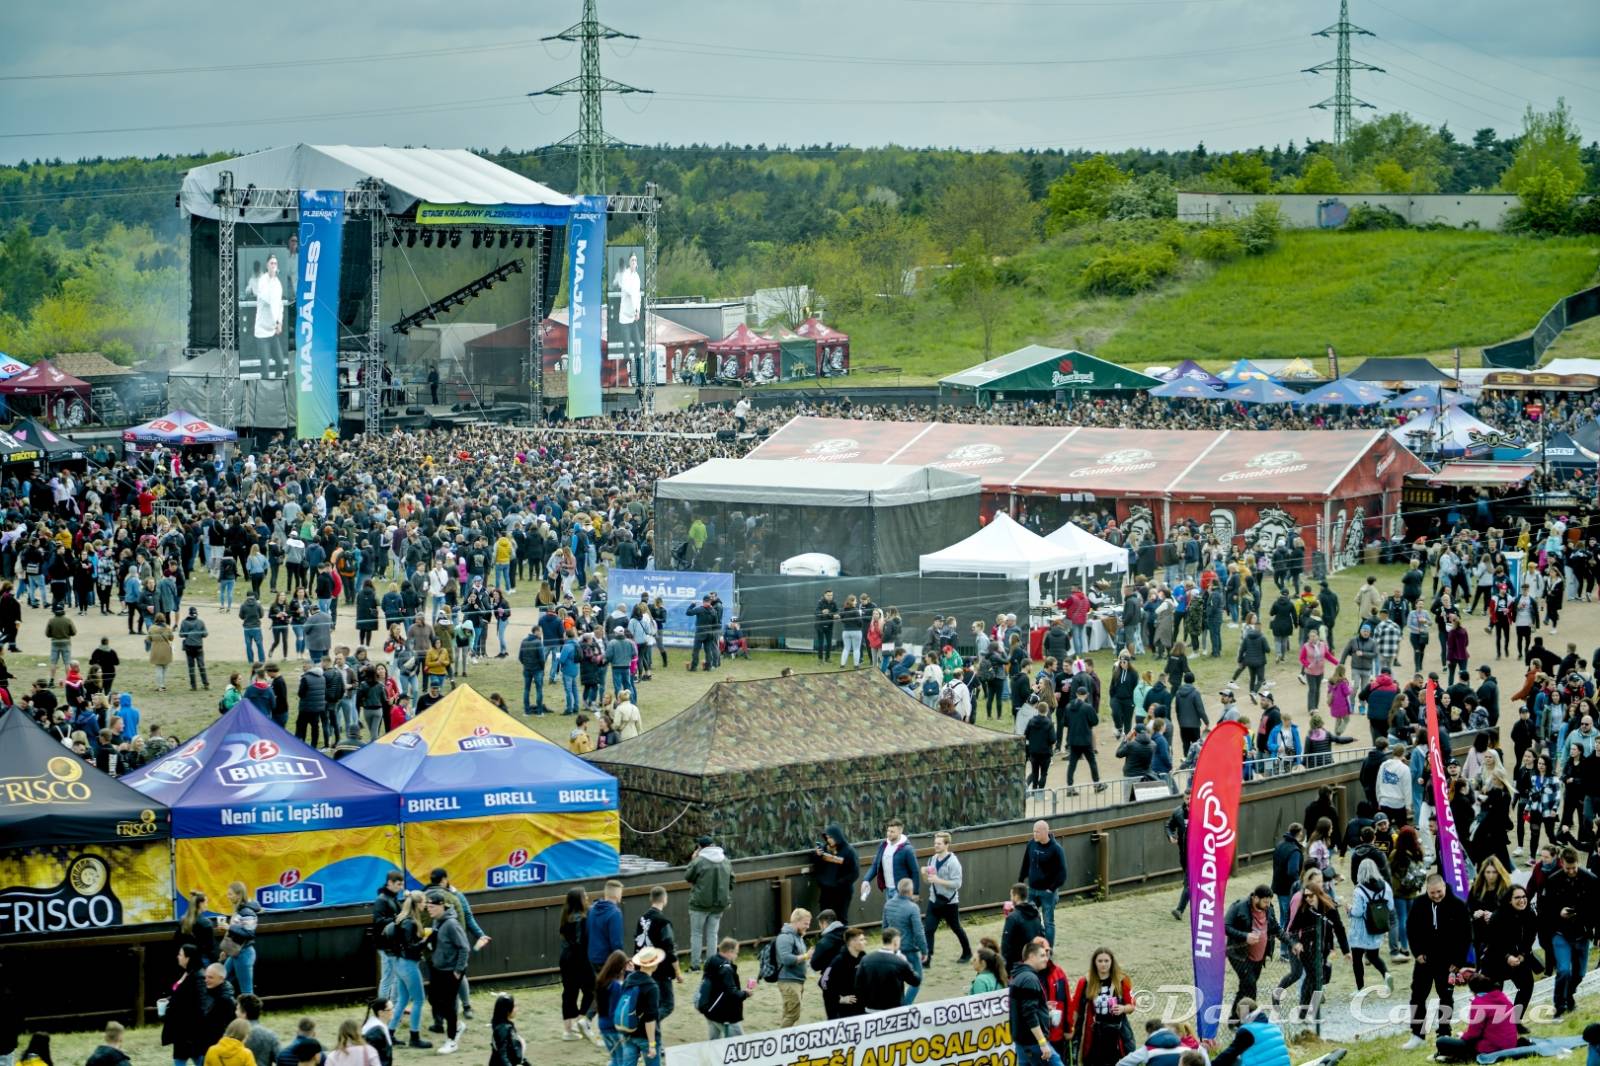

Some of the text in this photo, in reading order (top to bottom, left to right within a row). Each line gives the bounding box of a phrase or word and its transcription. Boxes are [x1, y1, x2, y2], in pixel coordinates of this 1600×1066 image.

[300, 240, 321, 392] MAJÁLES
[572, 239, 588, 376] MAJÁLES
[622, 583, 697, 598] MAJÁLES
[463, 737, 509, 749] BIRELL
[229, 762, 314, 782] BIRELL
[0, 780, 91, 803] RISCO
[484, 791, 537, 807] BIRELL
[559, 789, 610, 803] BIRELL
[221, 803, 343, 825] Není nic lepšího
[408, 797, 461, 813] BIRELL
[116, 822, 157, 836] FRISCO
[493, 868, 541, 884] BIRELL
[262, 888, 317, 904] BIRELL
[1195, 833, 1217, 958] HITRÁDIO
[724, 1037, 779, 1064] AUTO
[780, 1023, 861, 1053] HORNÁT,
[864, 1008, 921, 1038] PLZEŇ
[860, 1021, 1014, 1066] AUTOSALON
